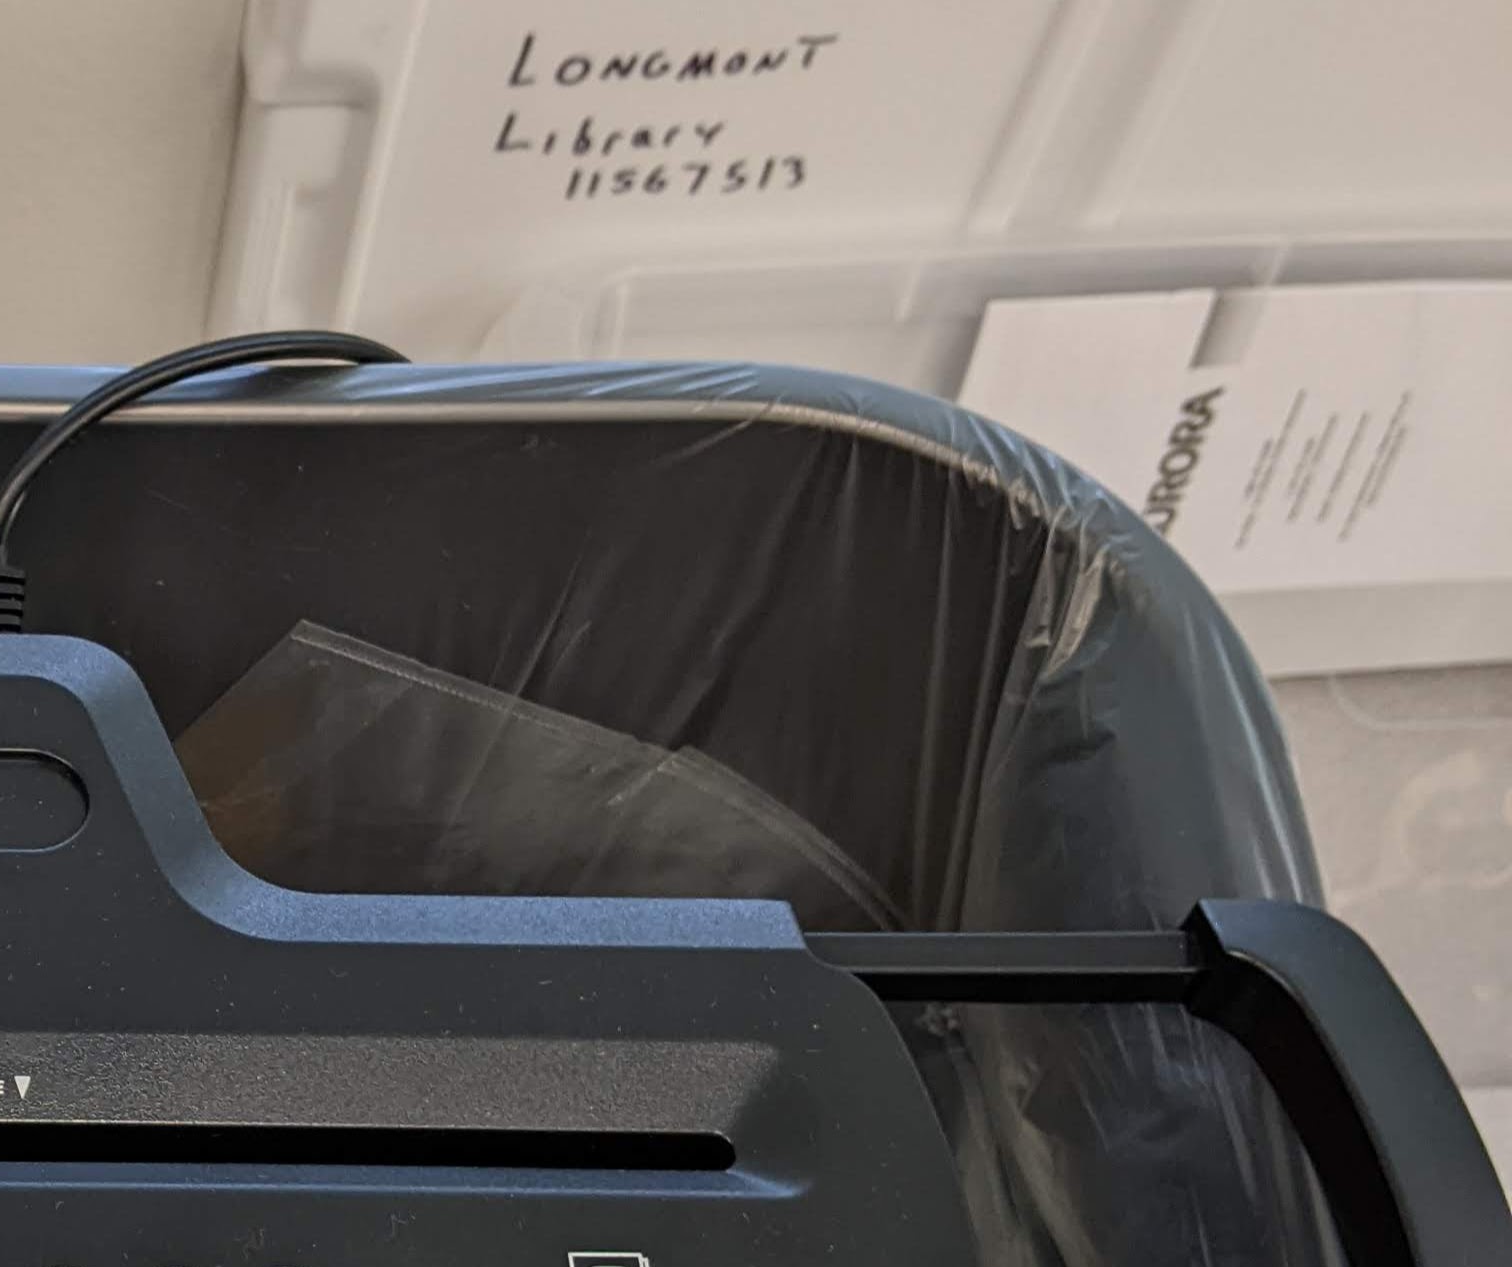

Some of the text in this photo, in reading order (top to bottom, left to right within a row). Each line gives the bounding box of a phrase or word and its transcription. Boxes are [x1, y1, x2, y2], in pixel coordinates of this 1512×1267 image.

[508, 33, 838, 87] LONGMONT
[495, 113, 722, 156] Library
[565, 156, 807, 199] 11567513
